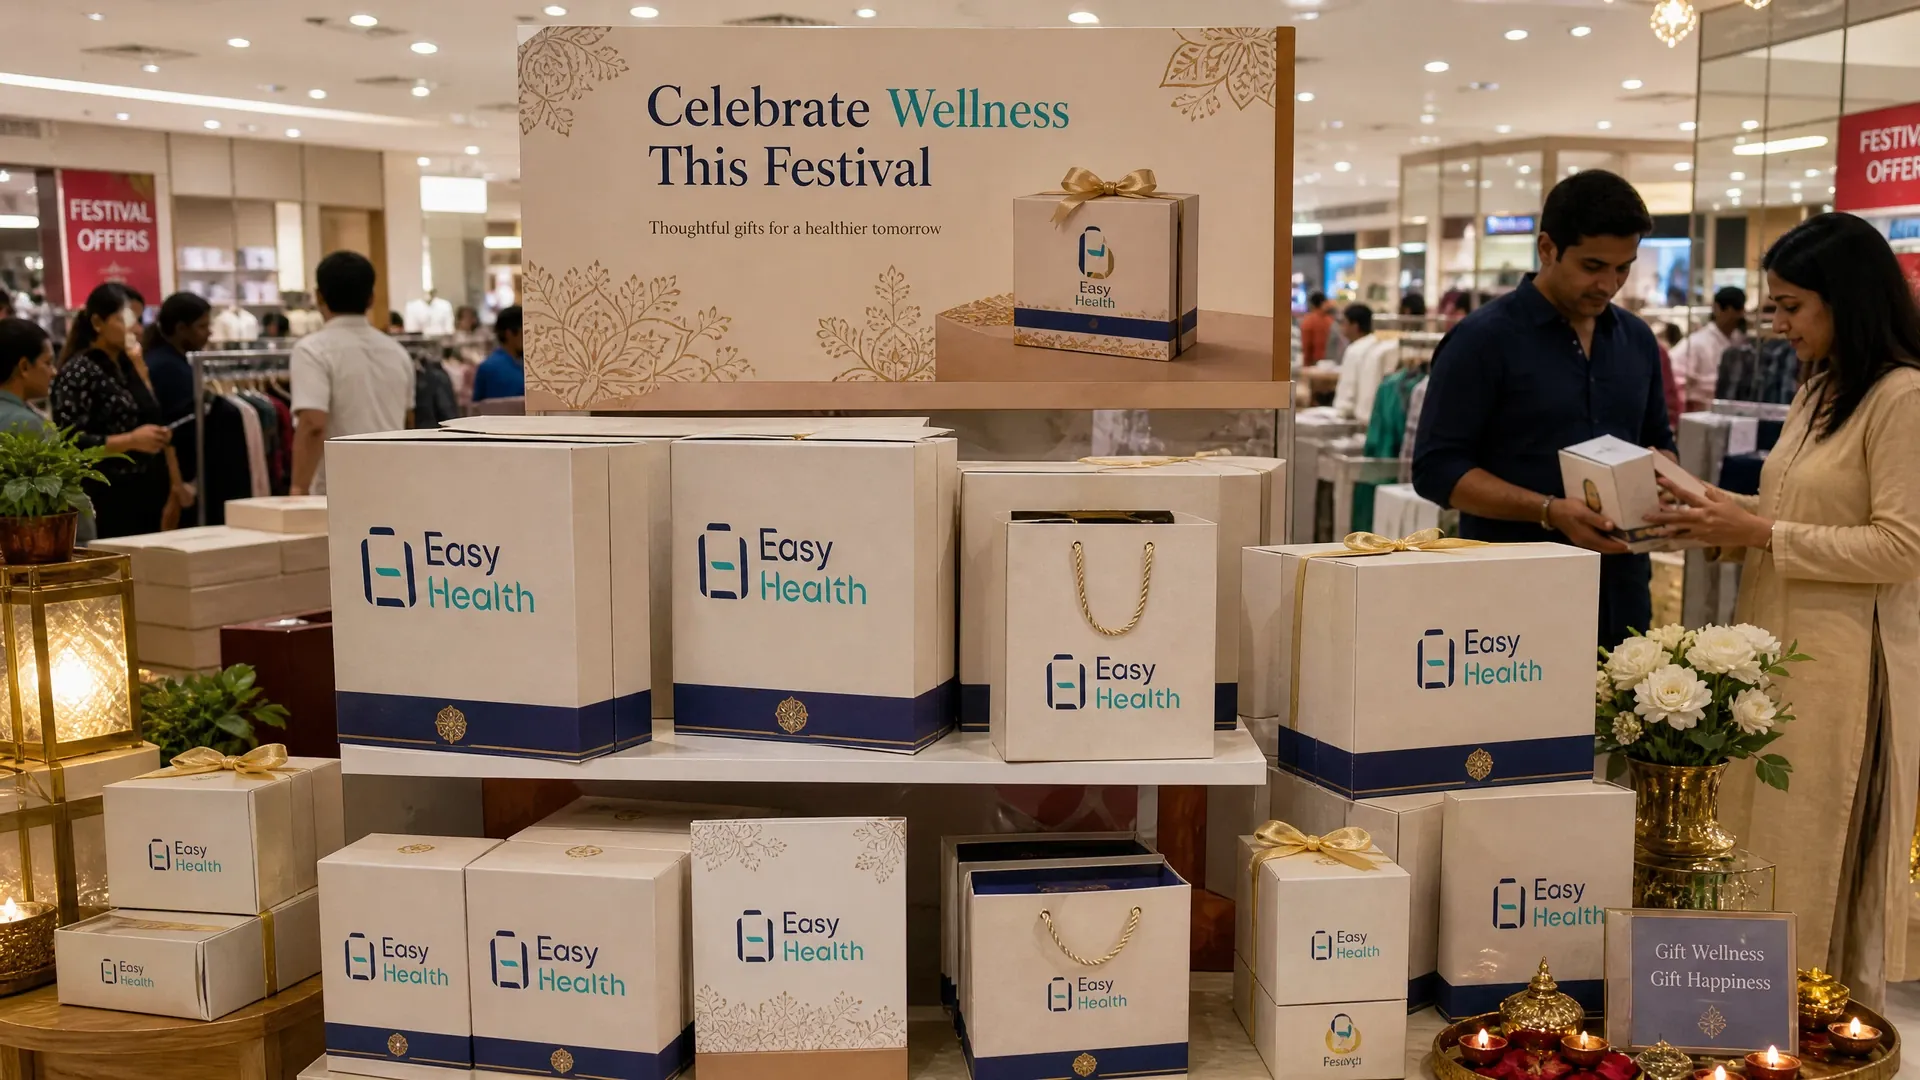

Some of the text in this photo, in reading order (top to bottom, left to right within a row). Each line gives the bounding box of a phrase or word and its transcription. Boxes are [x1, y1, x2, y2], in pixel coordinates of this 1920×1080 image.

[648, 85, 1069, 129] Celebrate Wellness
[1859, 123, 1920, 154] FESTIV
[649, 144, 932, 187] This Festival
[69, 198, 153, 223] FESTIVAL
[77, 228, 150, 253] OFFERS
[649, 220, 942, 238] Thoughtful gifts for a healthier tomorrow
[1075, 295, 1115, 309] Health
[1079, 281, 1111, 298] Easy
[424, 531, 500, 575] Easy
[760, 528, 833, 570] Easy
[428, 576, 534, 613] Health
[761, 570, 867, 605] Health
[1465, 629, 1521, 658] Easy
[1096, 656, 1156, 685] Easy
[1464, 660, 1542, 686] Health
[1096, 687, 1180, 709] Health
[175, 841, 207, 859] Easy
[175, 858, 222, 873] Health
[1534, 878, 1585, 904] Easy
[783, 911, 839, 938] Easy
[1534, 903, 1605, 928] Health
[382, 936, 429, 965] Easy
[783, 940, 864, 962] Health
[1337, 931, 1368, 946] Easy
[1337, 943, 1380, 959] Health
[538, 935, 599, 969] Easy
[1655, 943, 1764, 961] Gift Wellness
[119, 960, 144, 976] Easy
[383, 962, 449, 986] Health
[120, 974, 154, 988] Health
[539, 966, 625, 997] Health
[1078, 977, 1114, 994] Easy
[1650, 970, 1771, 993] Gift Happiness
[1078, 994, 1127, 1010] Health
